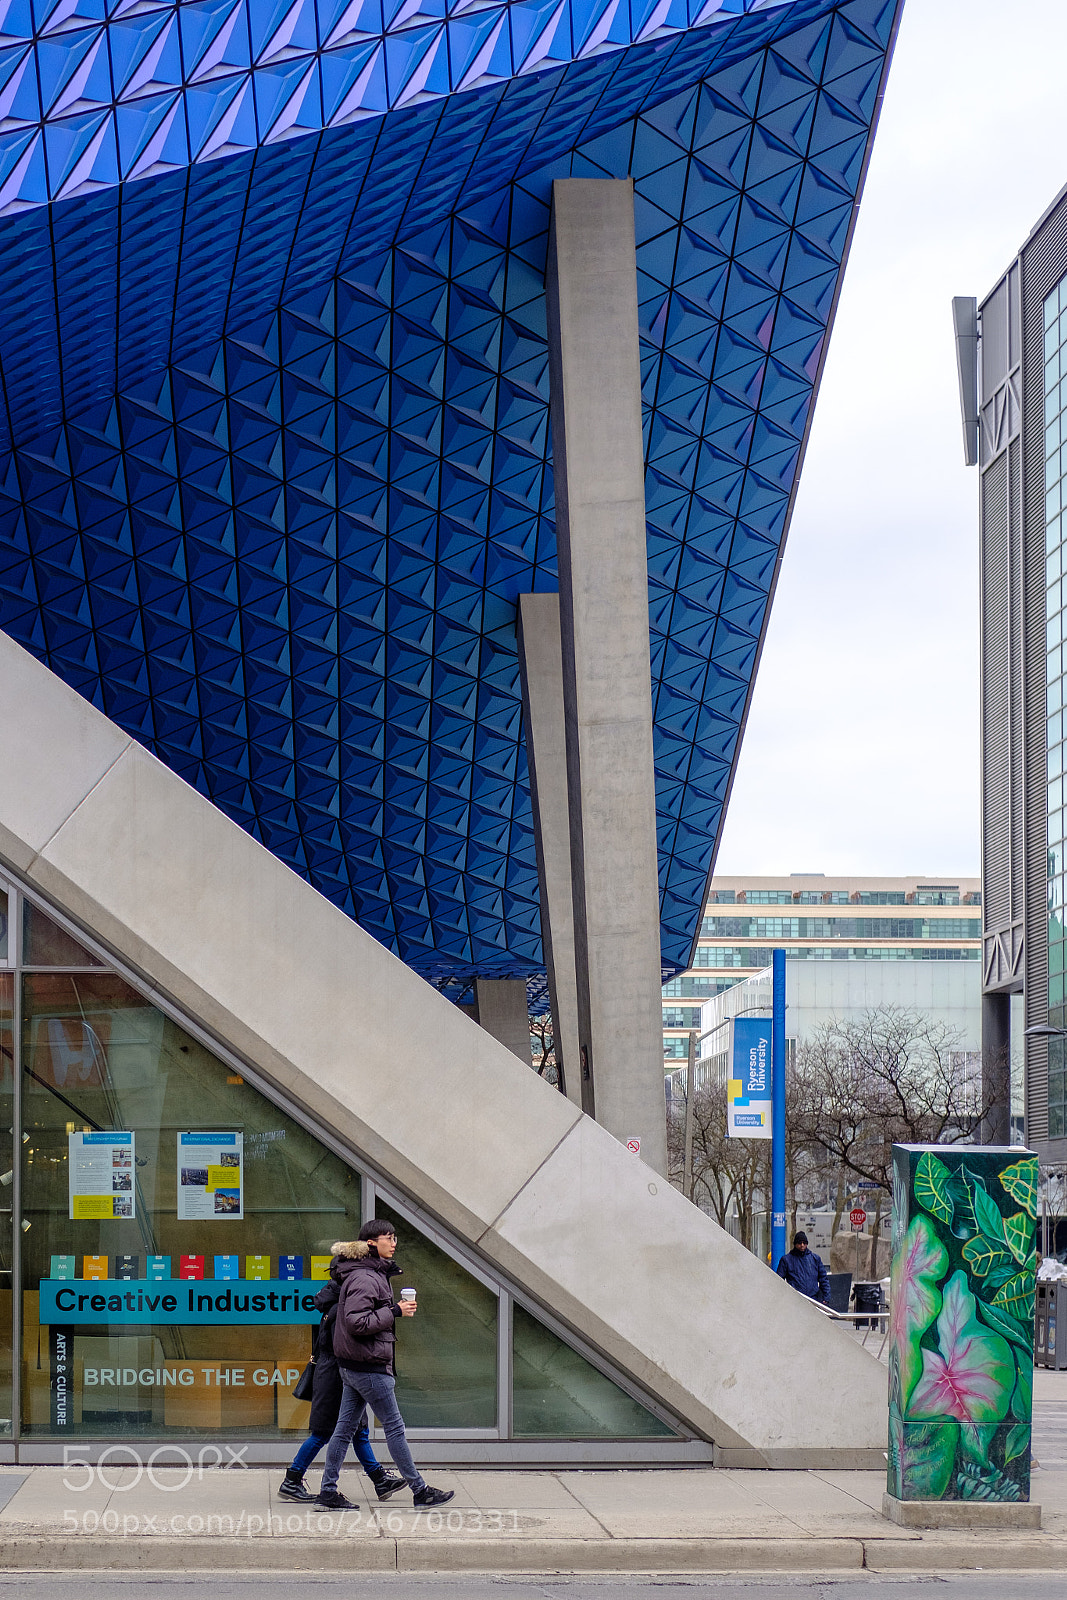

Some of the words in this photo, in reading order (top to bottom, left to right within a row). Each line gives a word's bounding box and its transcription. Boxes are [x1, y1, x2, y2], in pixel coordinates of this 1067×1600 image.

[747, 1047, 759, 1091] Ryerson
[756, 1037, 768, 1091] University
[850, 1212, 866, 1221] STOP
[55, 1288, 178, 1312] Creative
[56, 1333, 67, 1361] ARTS
[56, 1364, 67, 1374] &
[83, 1368, 195, 1386] BRIDGING
[201, 1368, 245, 1386] THE
[252, 1368, 300, 1386] GAP
[56, 1376, 67, 1425] CULTURE
